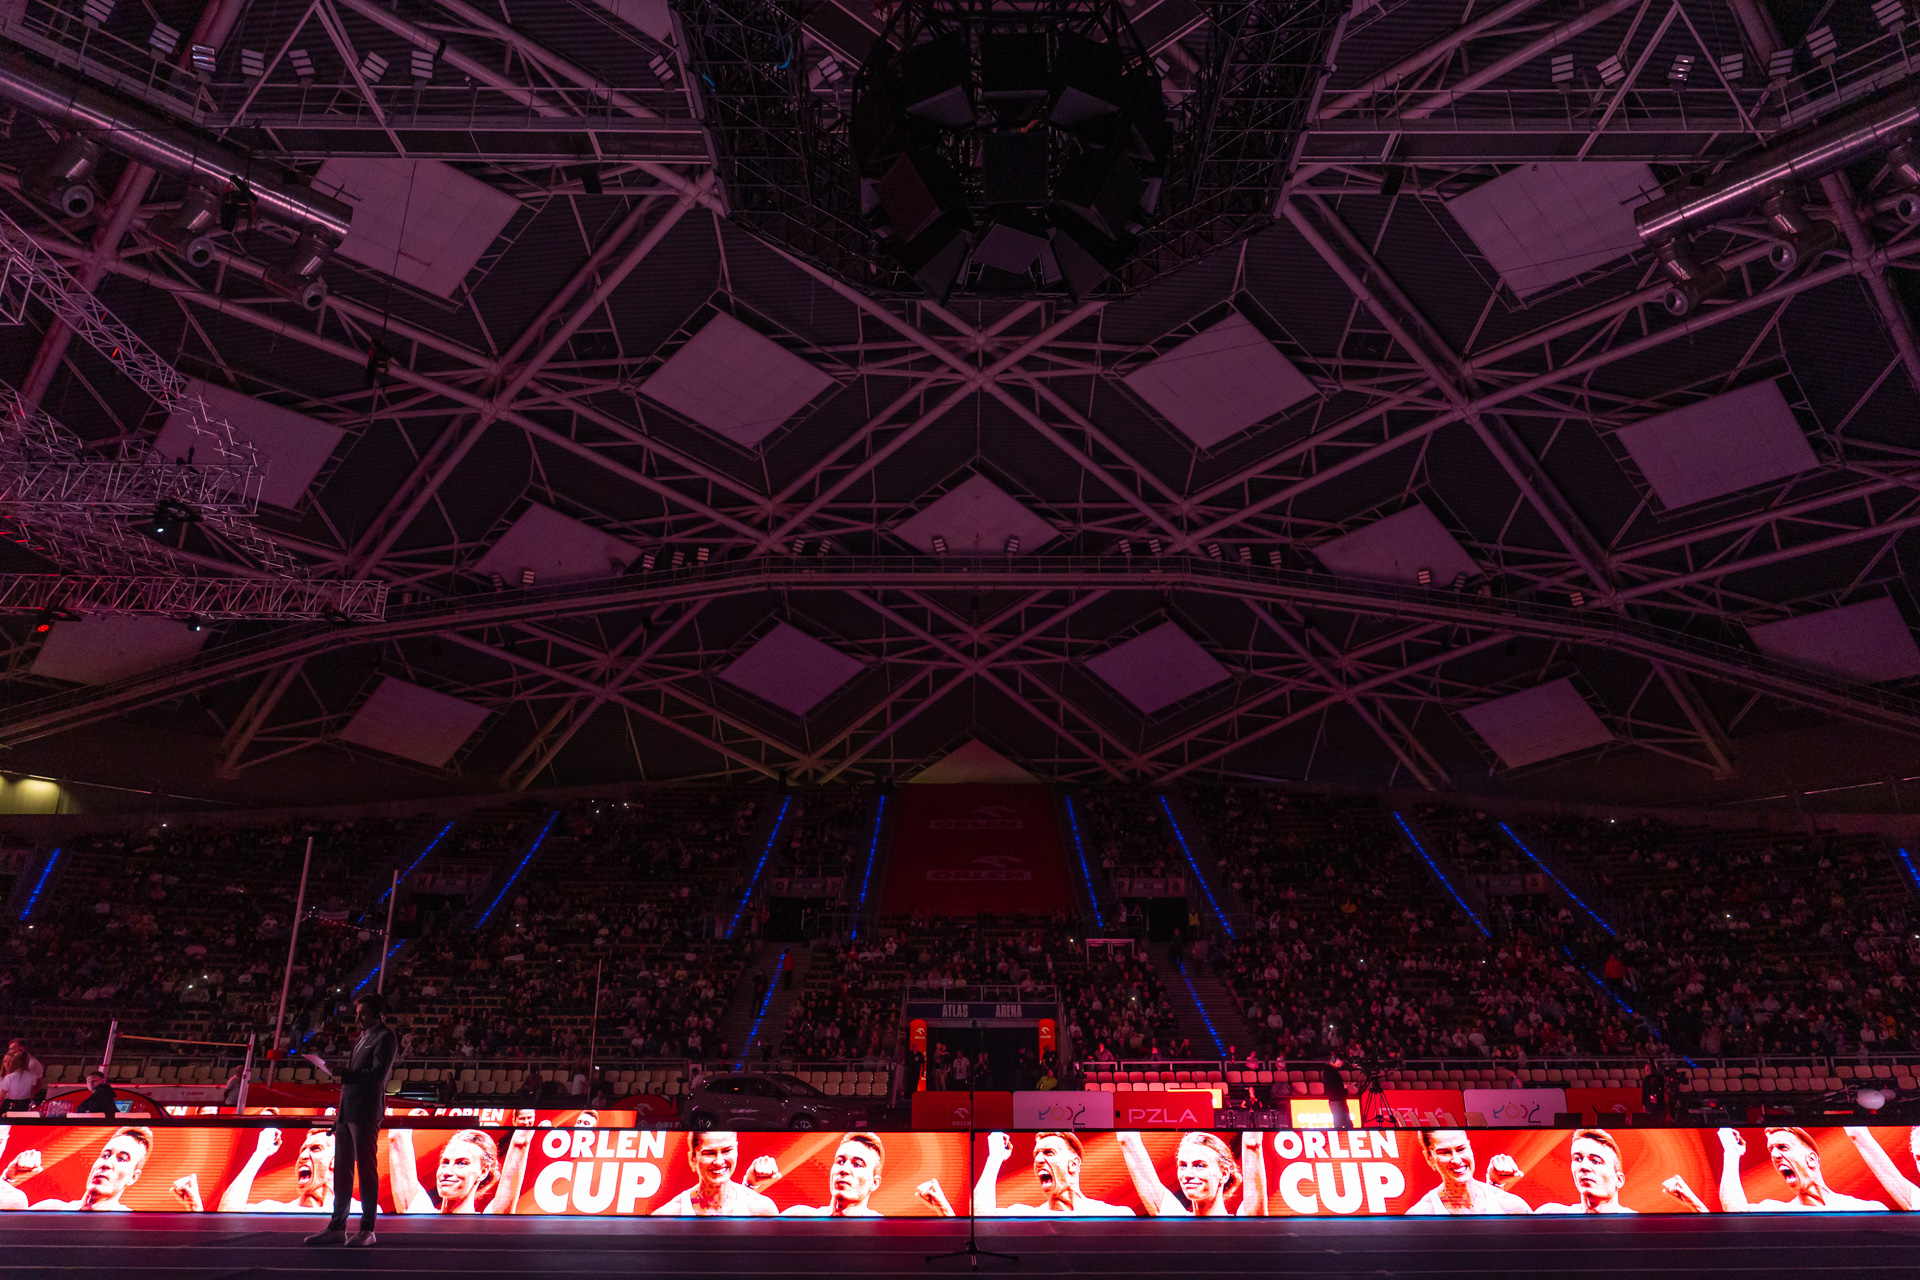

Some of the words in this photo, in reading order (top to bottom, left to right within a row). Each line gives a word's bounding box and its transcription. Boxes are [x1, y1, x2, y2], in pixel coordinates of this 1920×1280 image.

[931, 870, 1026, 880] ORLEN
[941, 1004, 969, 1018] ATLAS
[995, 1004, 1023, 1018] ARENA
[1128, 1108, 1198, 1123] PZLA
[542, 1130, 667, 1158] ORLEN
[1273, 1130, 1400, 1159] ORLEN
[533, 1160, 662, 1214] CUP
[1279, 1161, 1406, 1214] CUP
